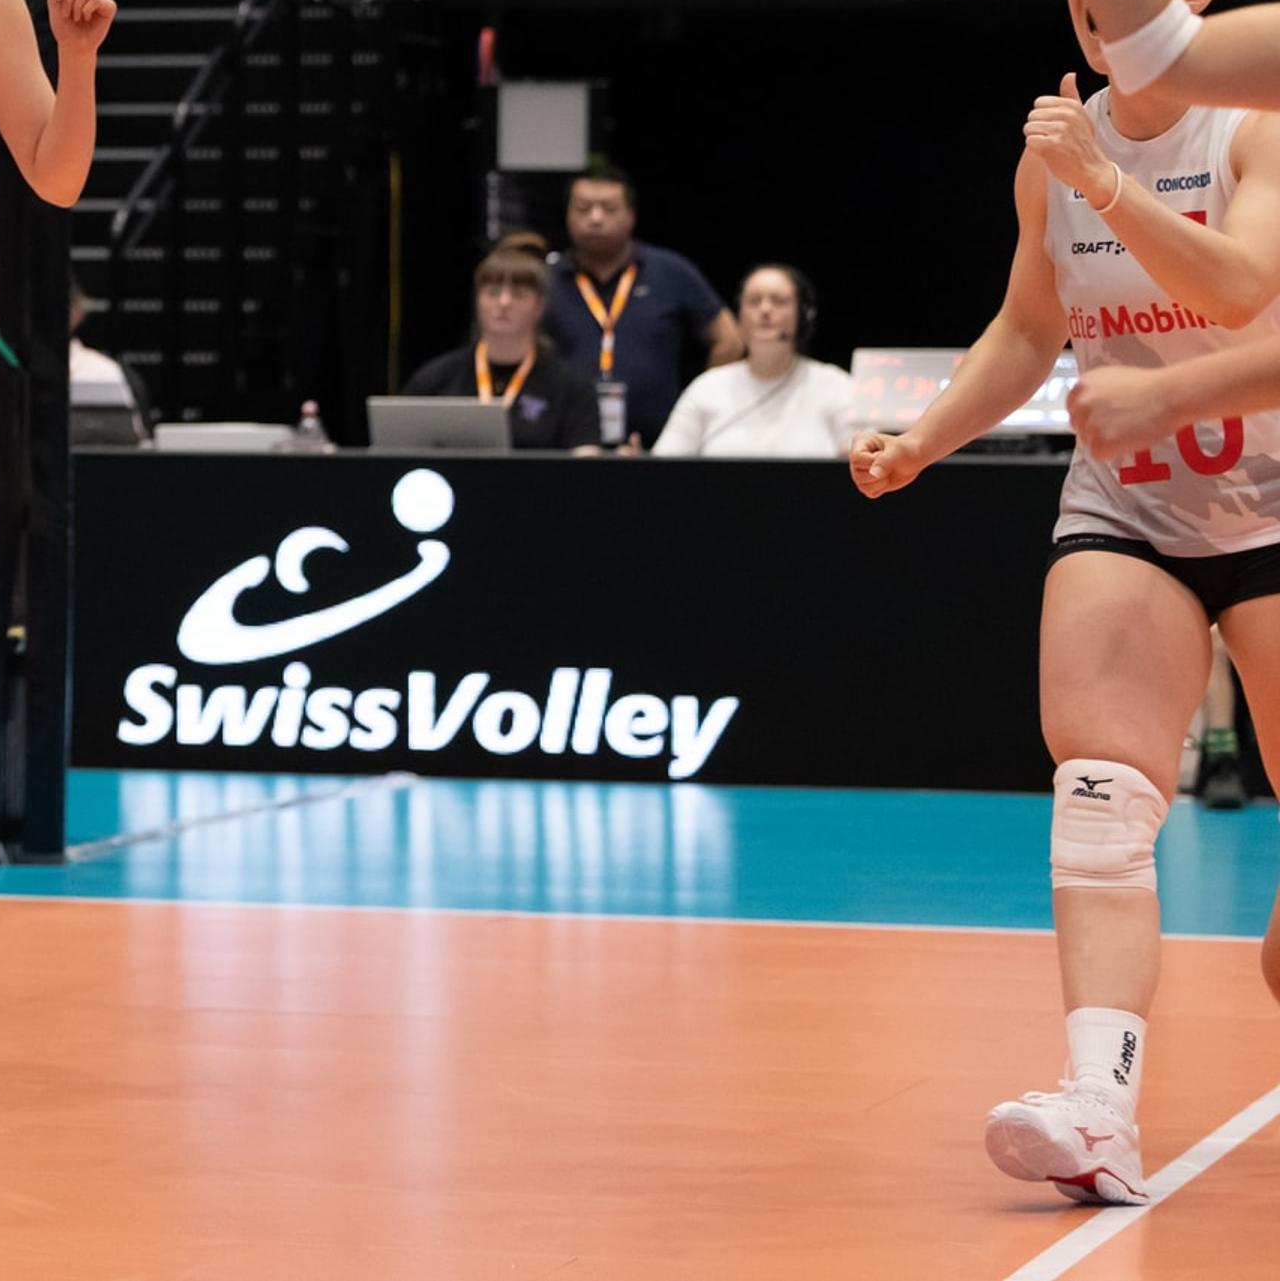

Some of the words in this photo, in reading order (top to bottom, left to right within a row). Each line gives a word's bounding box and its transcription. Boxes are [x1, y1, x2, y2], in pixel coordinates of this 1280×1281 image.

[1071, 241, 1114, 255] CRAFT
[1068, 306, 1097, 340] die
[117, 661, 740, 779] SwissVolley
[1120, 1031, 1137, 1074] CRAFT
